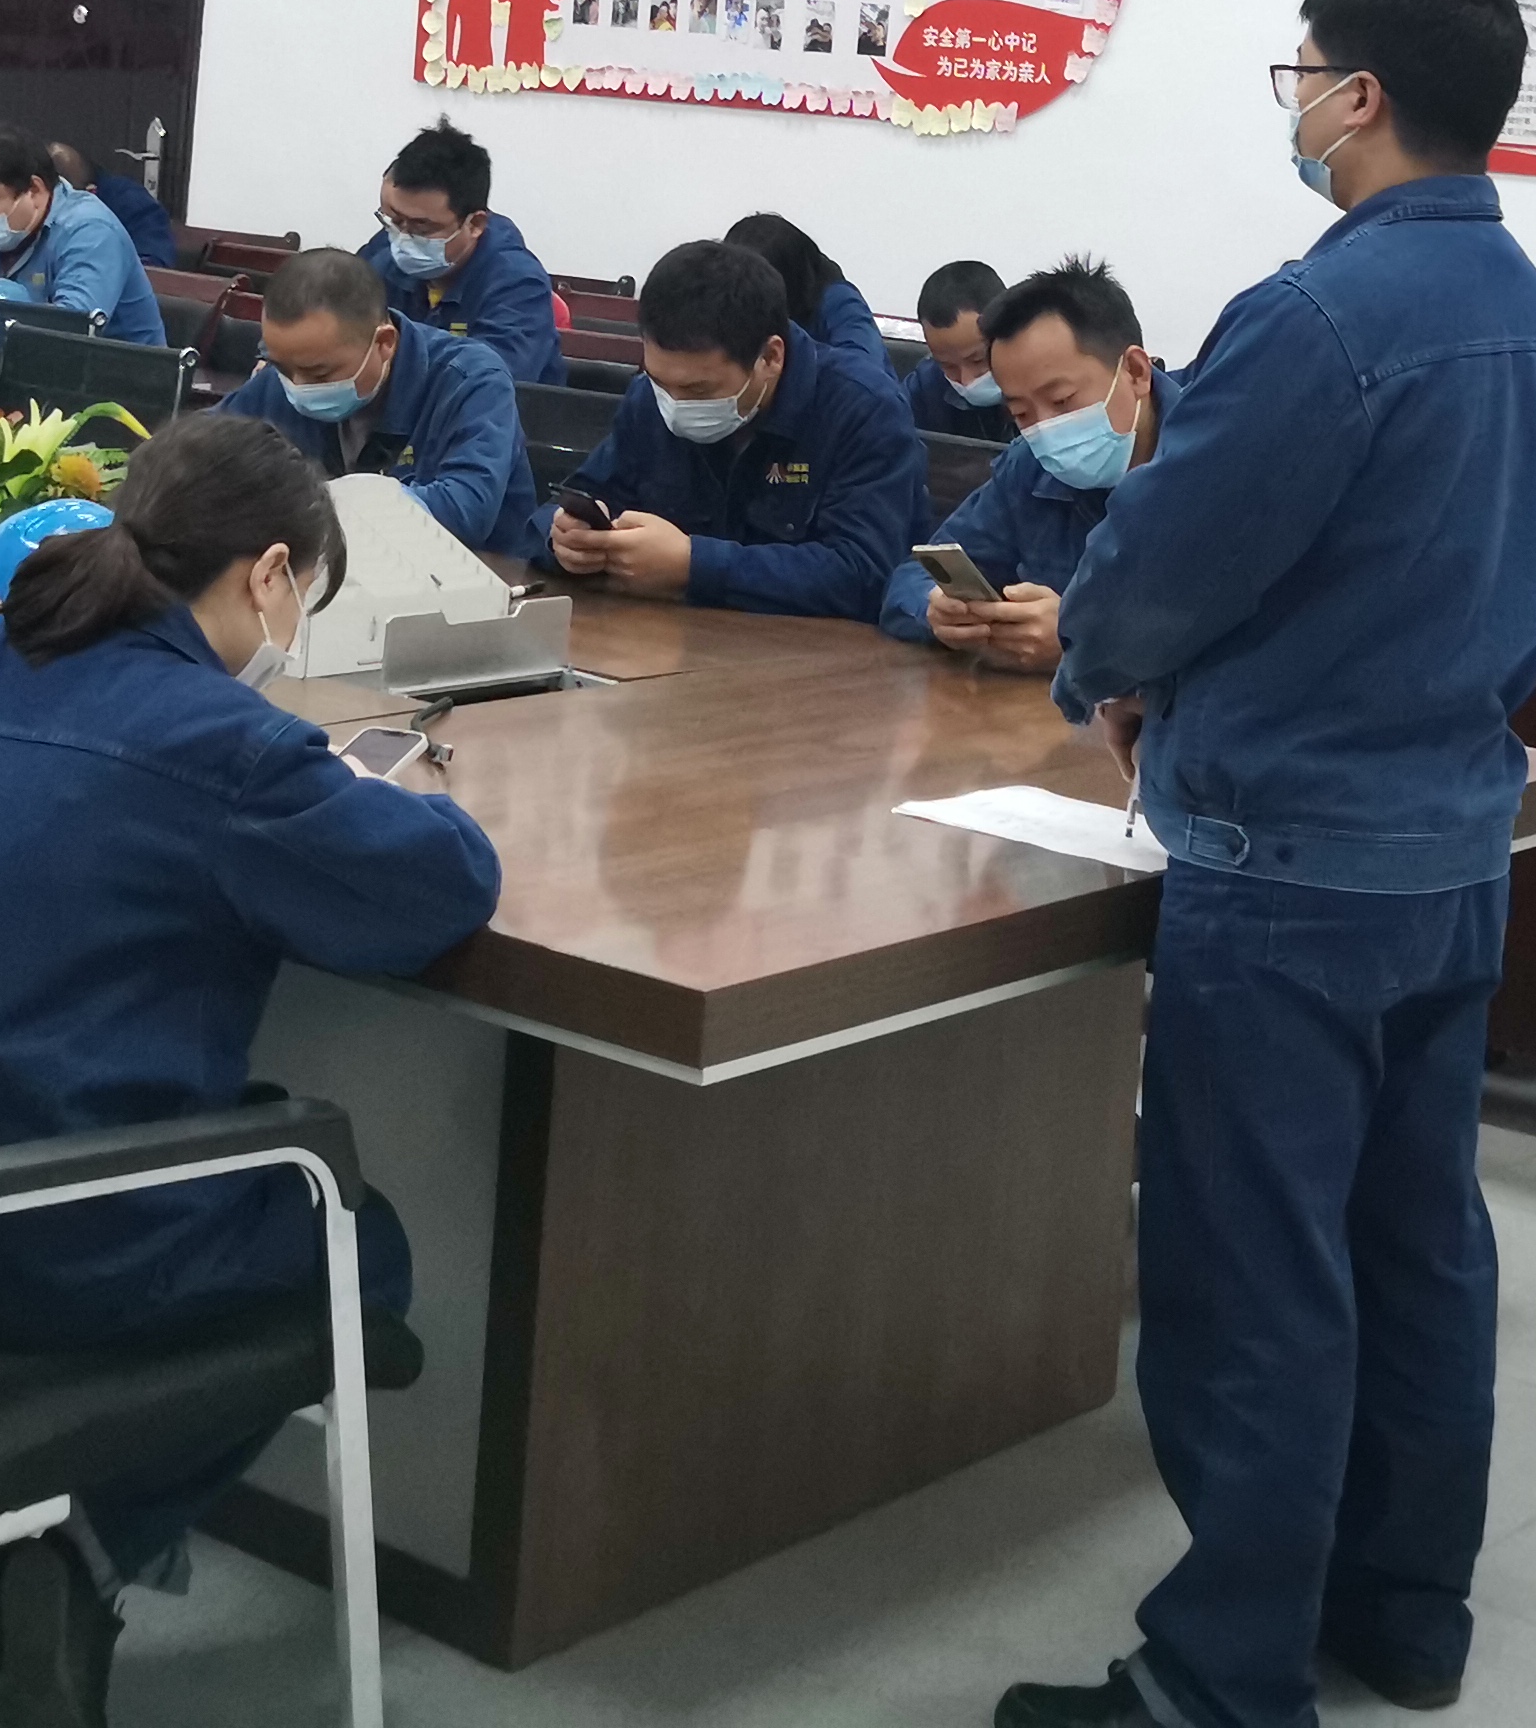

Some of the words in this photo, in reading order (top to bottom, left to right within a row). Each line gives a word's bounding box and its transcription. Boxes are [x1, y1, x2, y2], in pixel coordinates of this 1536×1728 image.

[922, 25, 1038, 54] 安全第一心中记
